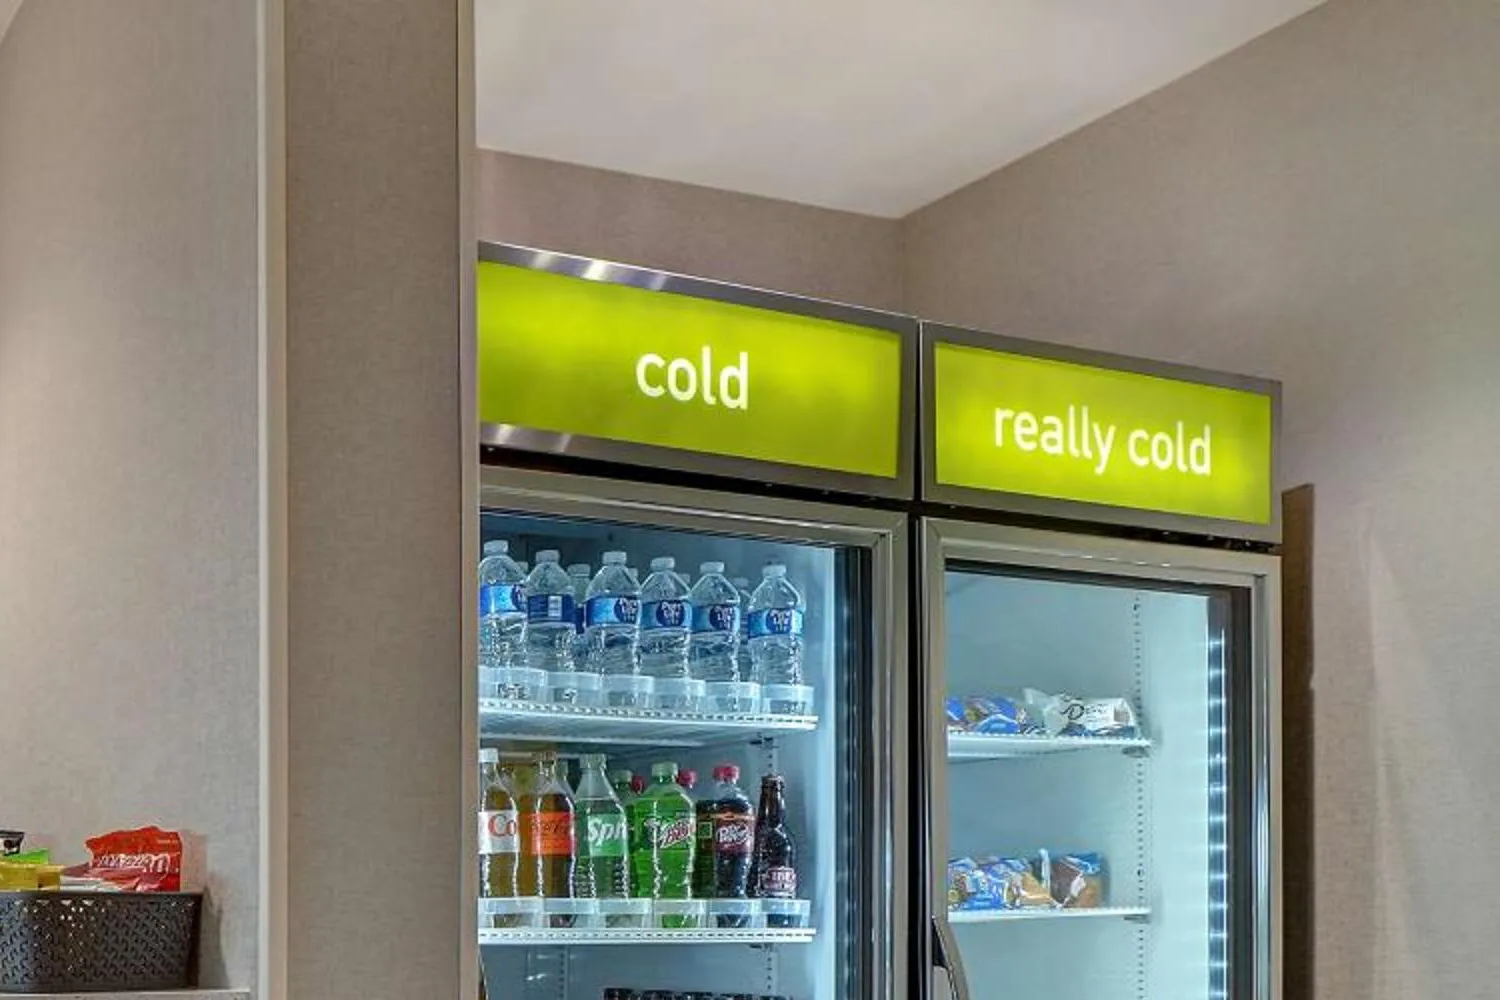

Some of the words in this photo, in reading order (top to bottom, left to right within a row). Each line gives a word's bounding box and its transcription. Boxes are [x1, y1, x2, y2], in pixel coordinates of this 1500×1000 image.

[635, 344, 749, 411] cold
[993, 403, 1117, 476] really
[1127, 420, 1212, 477] cold
